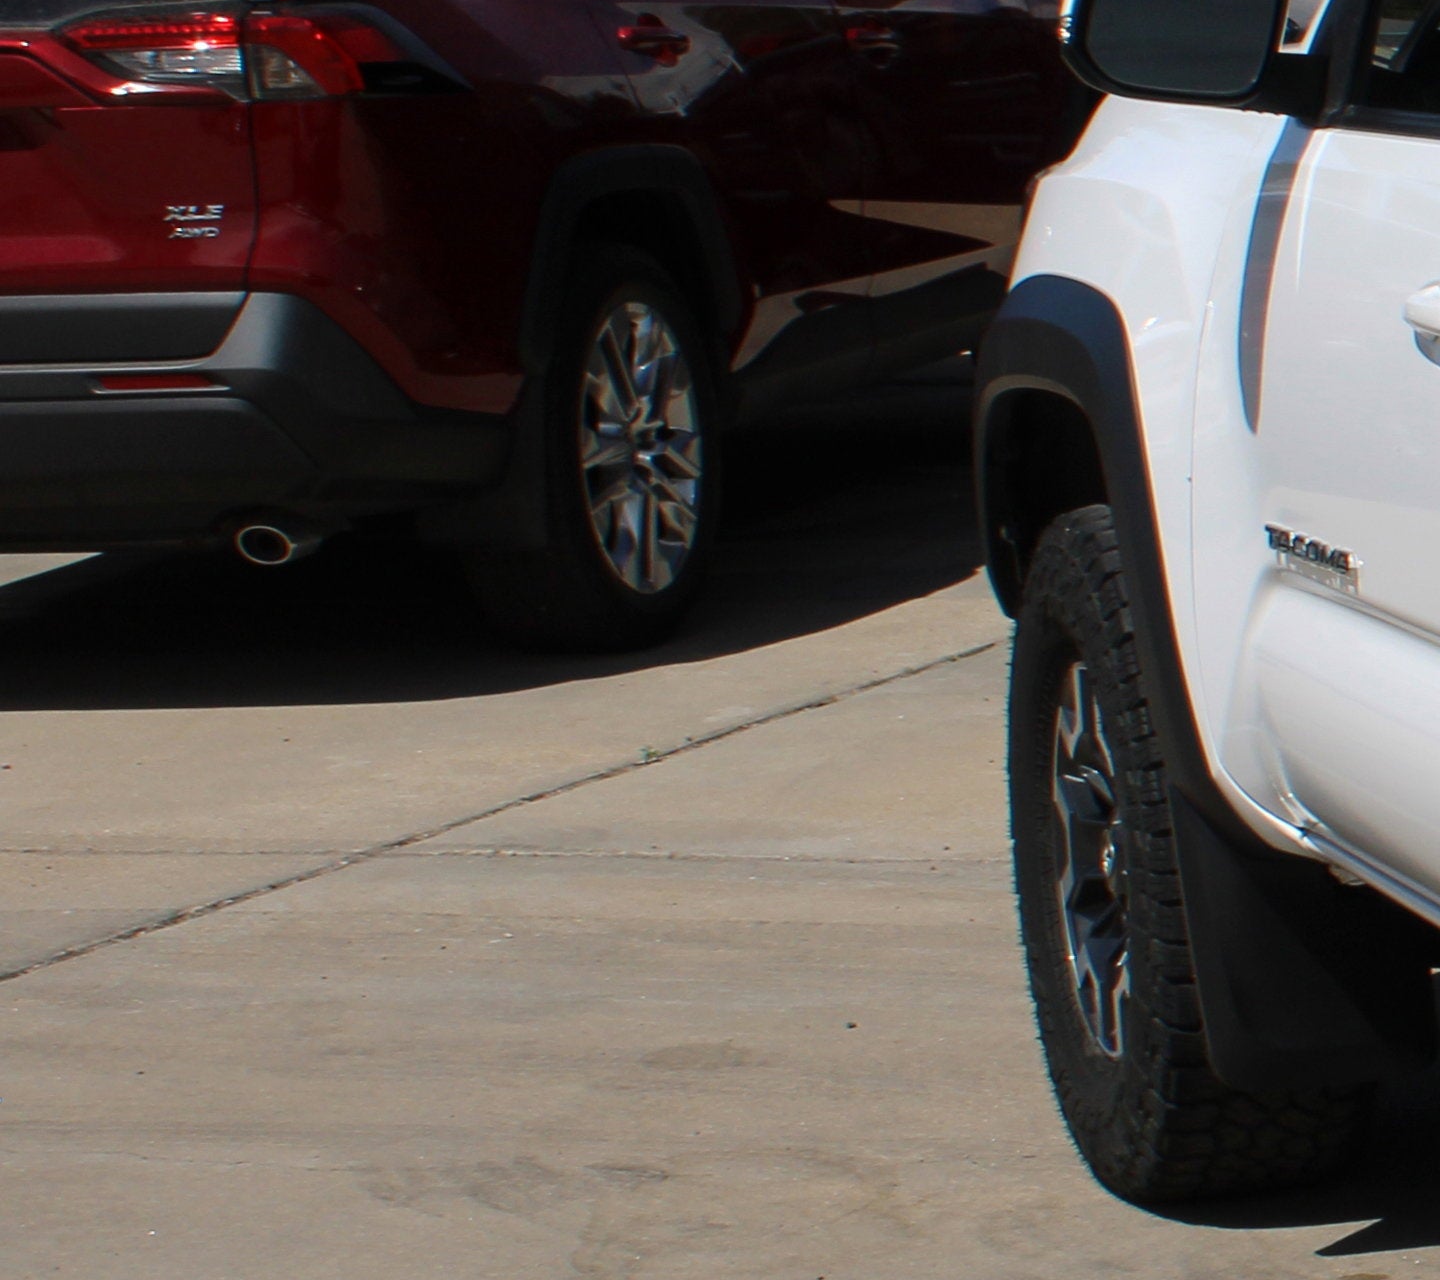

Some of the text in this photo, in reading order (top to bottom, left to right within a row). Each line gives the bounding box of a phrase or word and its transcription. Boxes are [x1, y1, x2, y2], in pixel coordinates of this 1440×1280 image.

[163, 204, 224, 221] XLE
[168, 226, 220, 239] AWD
[1263, 522, 1357, 574] TACOMA
